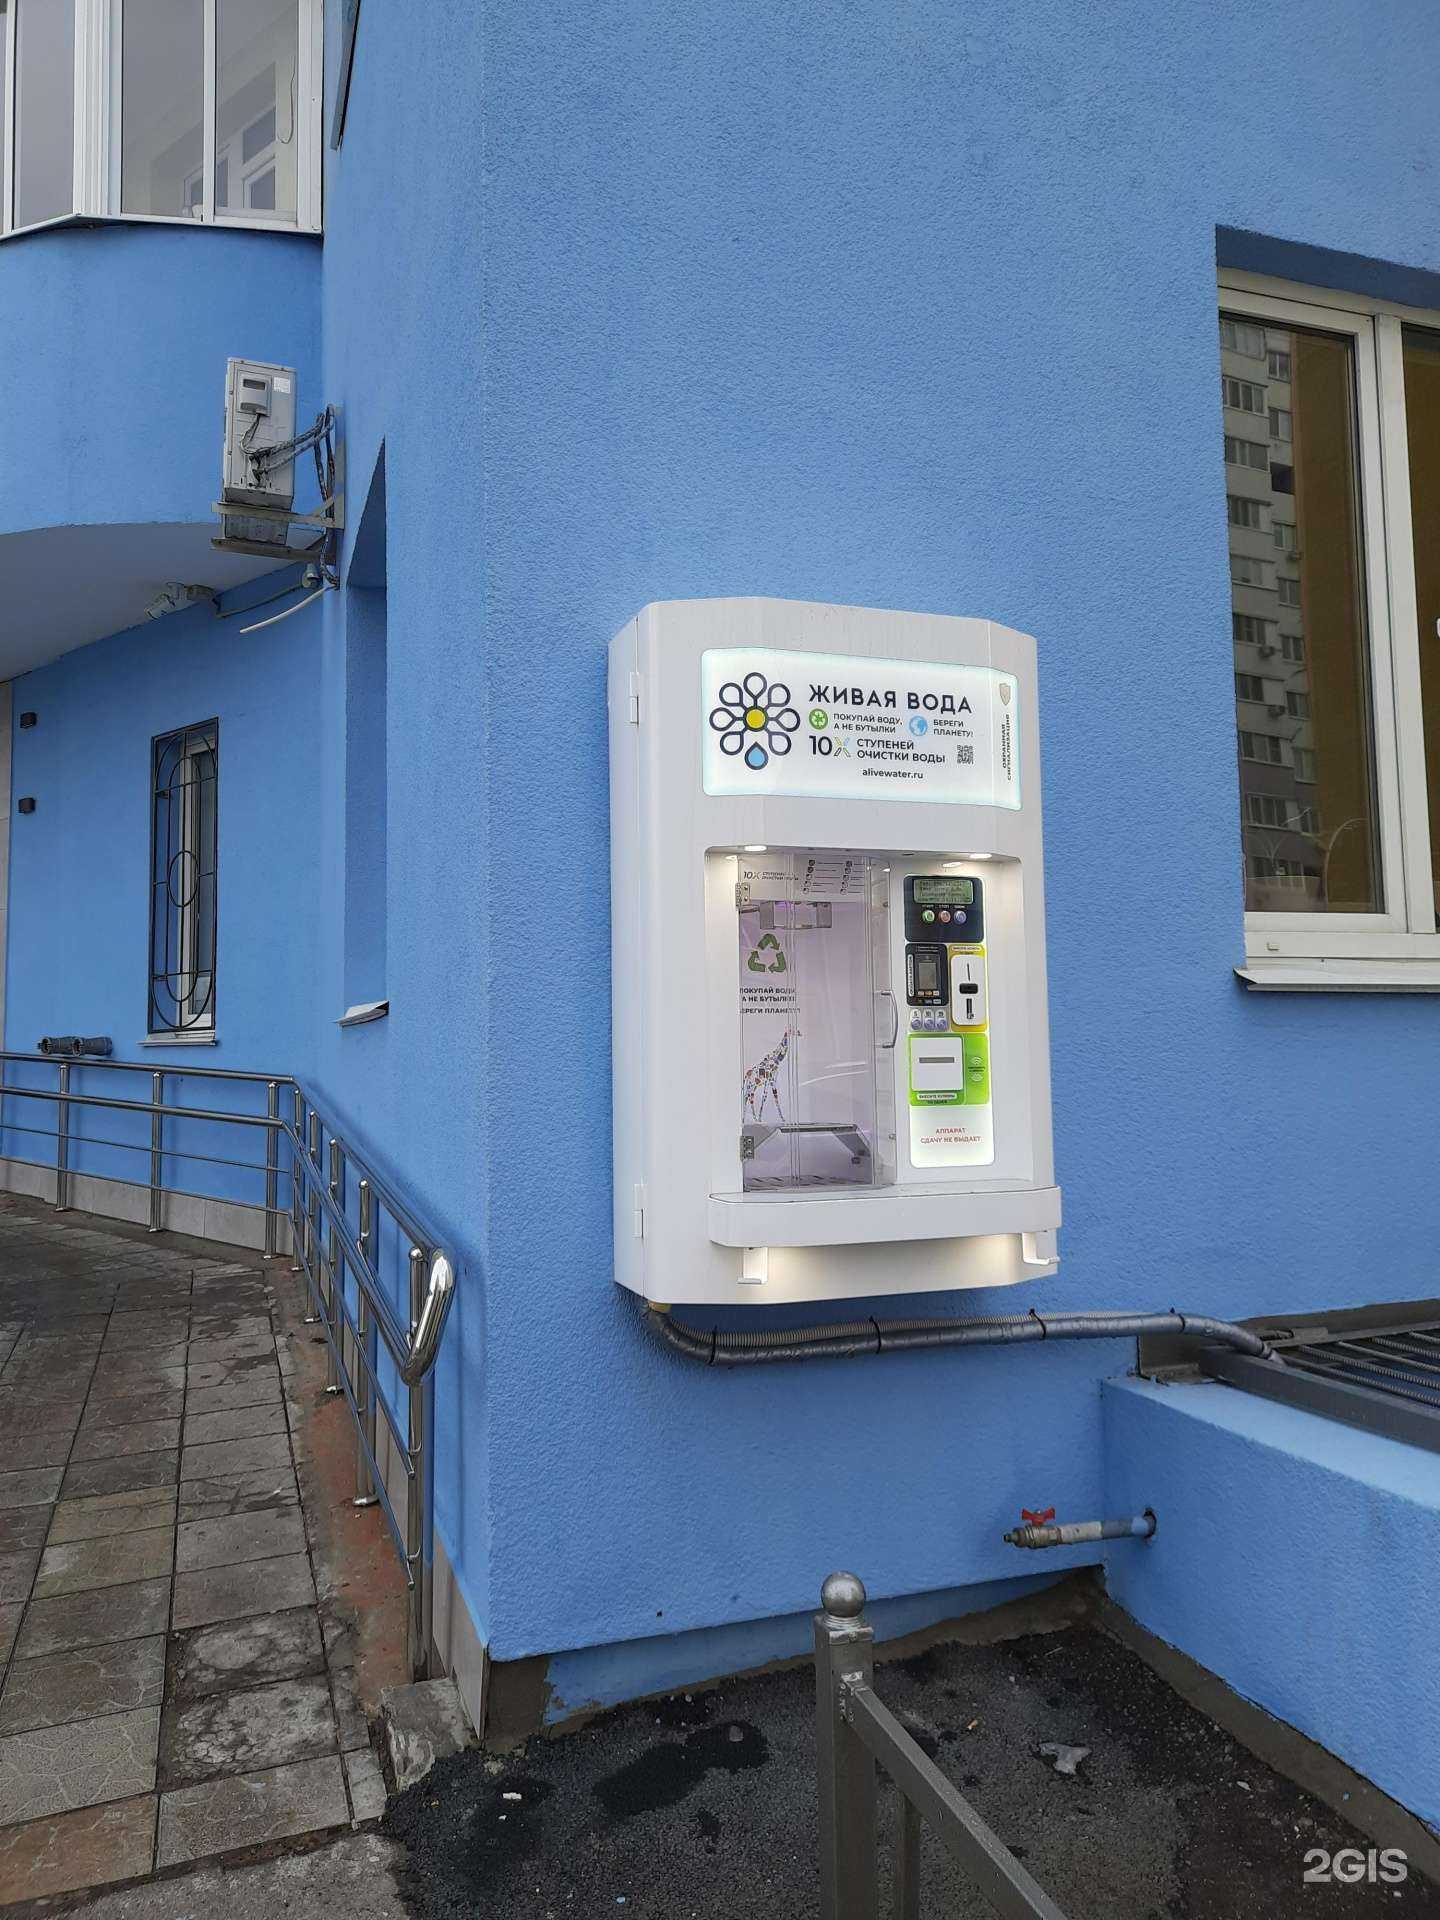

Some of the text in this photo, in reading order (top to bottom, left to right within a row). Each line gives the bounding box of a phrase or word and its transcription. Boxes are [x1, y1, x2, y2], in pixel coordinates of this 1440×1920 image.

[809, 684, 972, 715] ЖИВАЯ ВОДА
[834, 713, 875, 723] ПОКУПАЙ
[933, 719, 964, 728] БЕРЕГИ
[842, 723, 853, 731] НЕ
[855, 725, 896, 734] БУТЫЛКИ
[857, 738, 914, 750] СТУПЕНЕЙ
[857, 750, 945, 764] ОЧИСТКИ ВОДЫ
[862, 768, 924, 779] alivewater.ru
